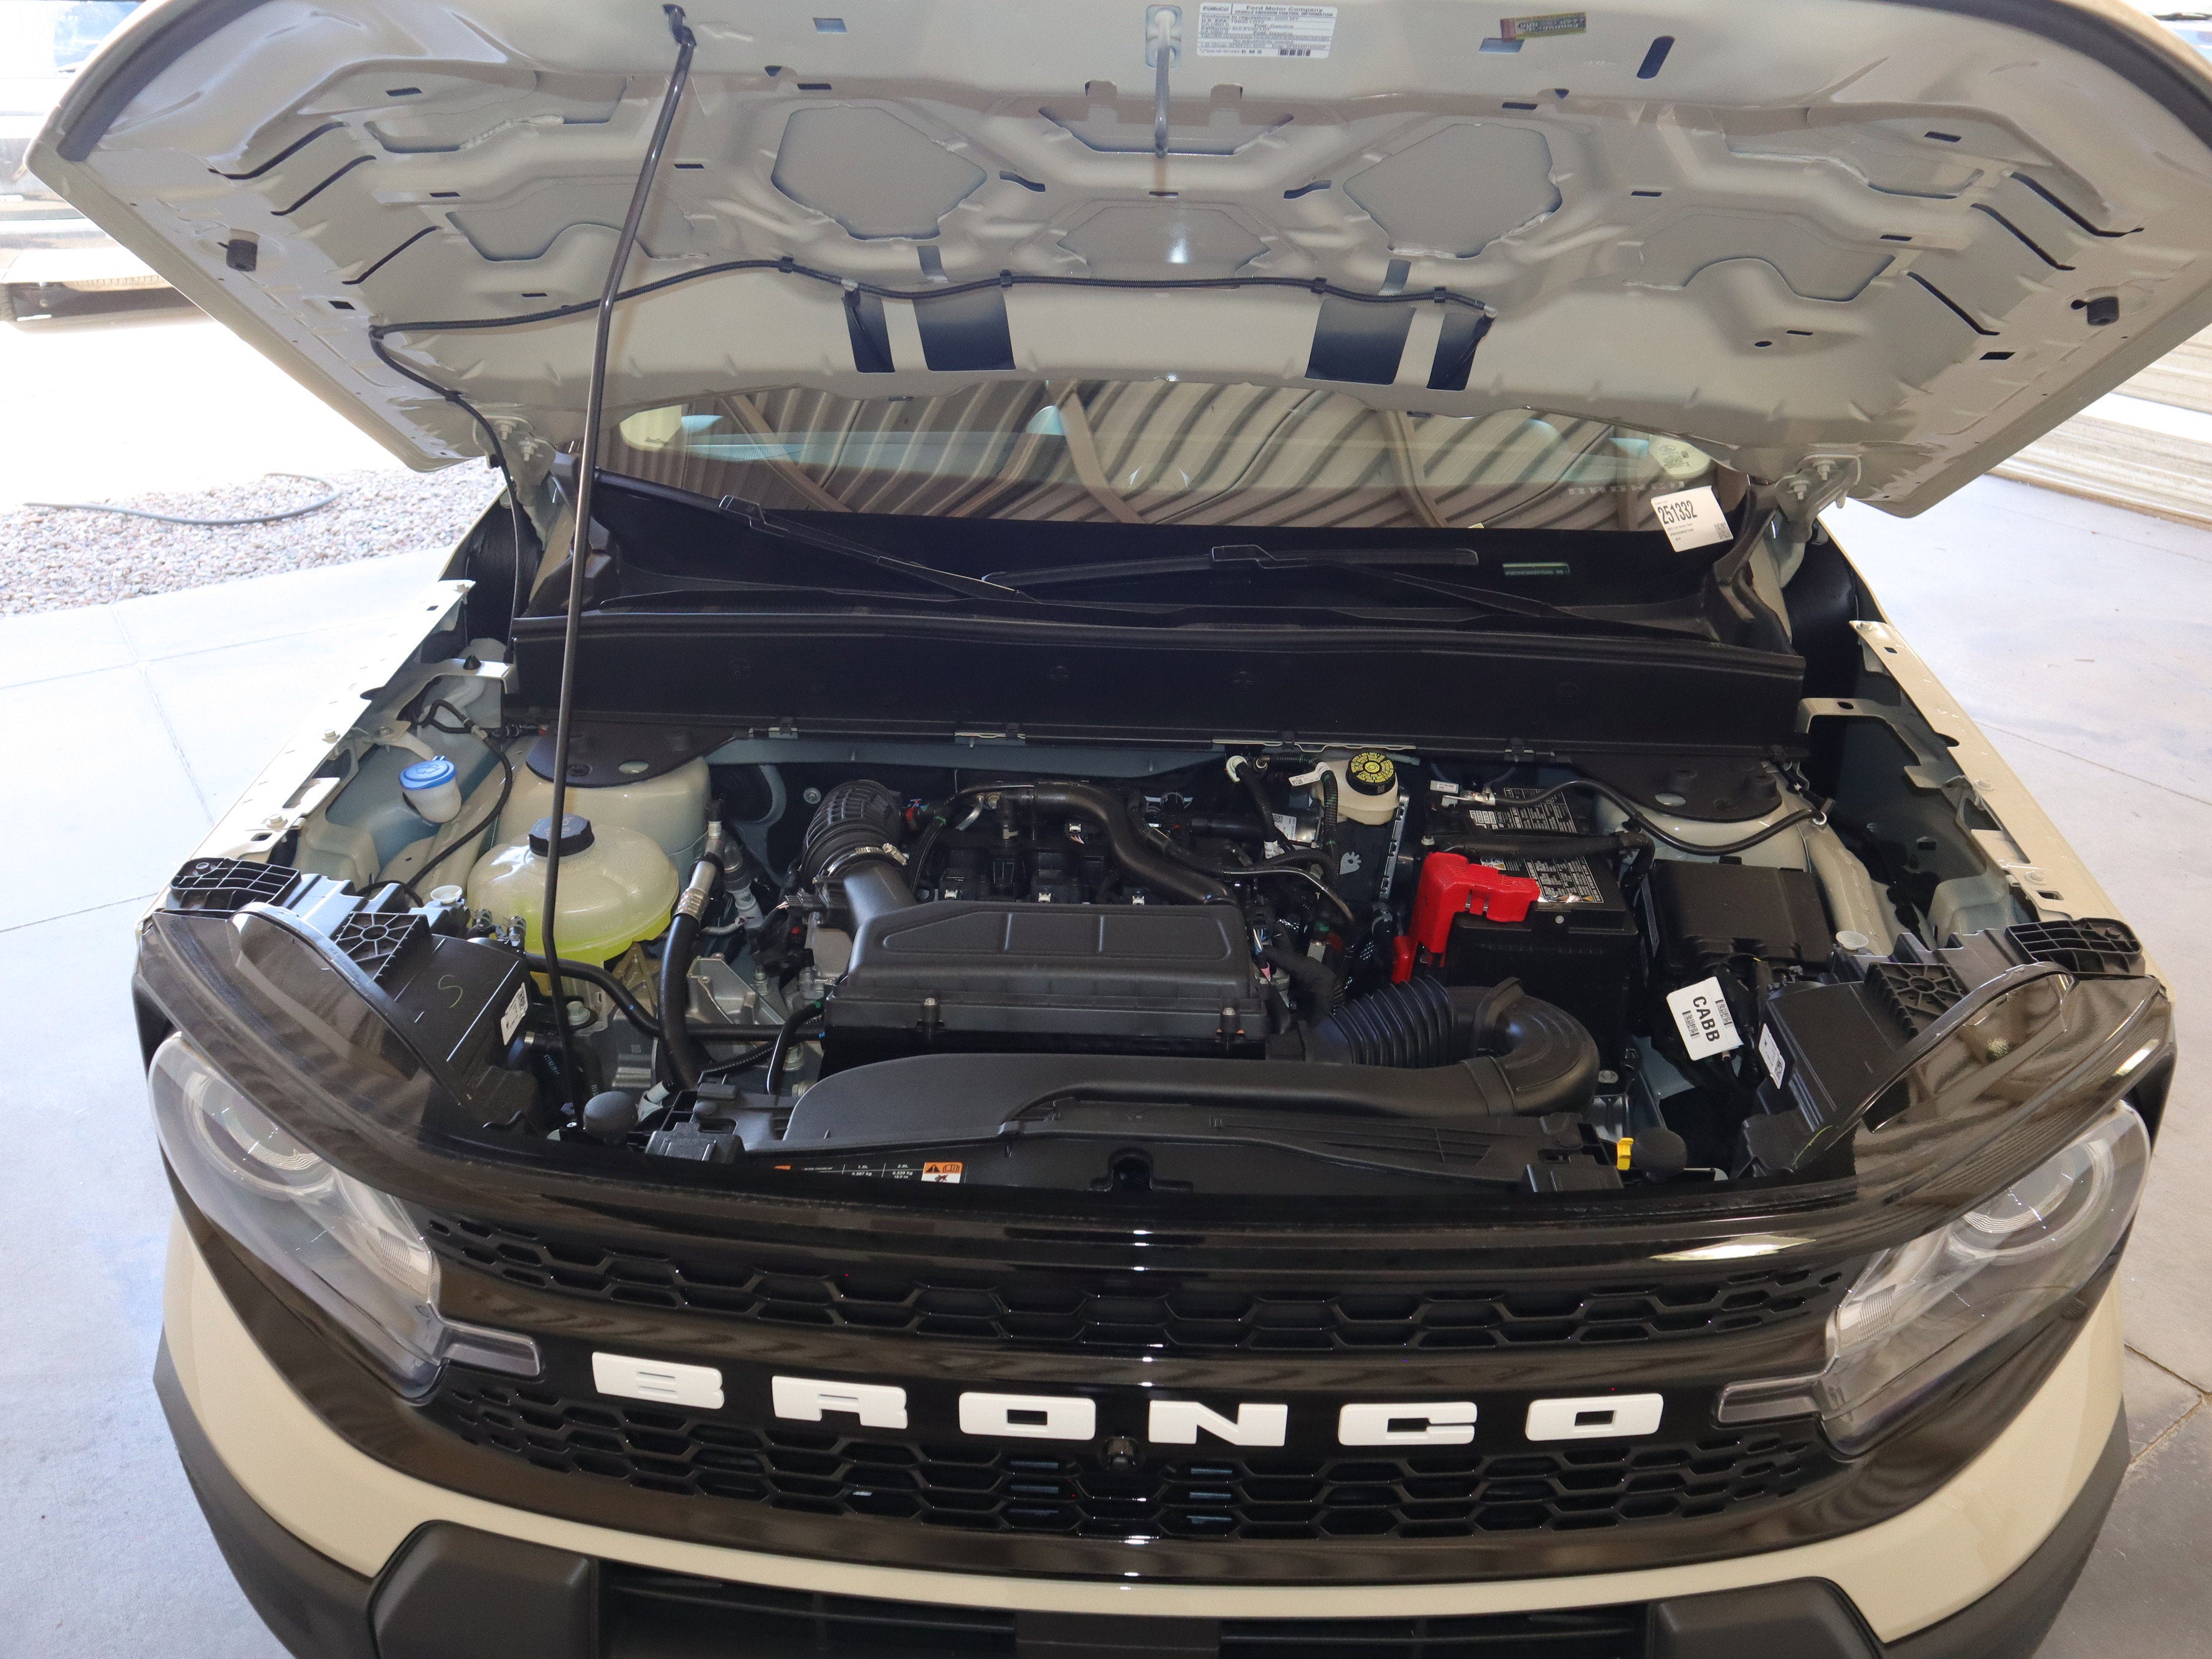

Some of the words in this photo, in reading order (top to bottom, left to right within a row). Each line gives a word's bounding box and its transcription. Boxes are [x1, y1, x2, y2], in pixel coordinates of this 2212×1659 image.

[1658, 500, 1698, 524] 251332
[1693, 996, 1721, 1042] CABB
[591, 1351, 1664, 1446] BRONCO
